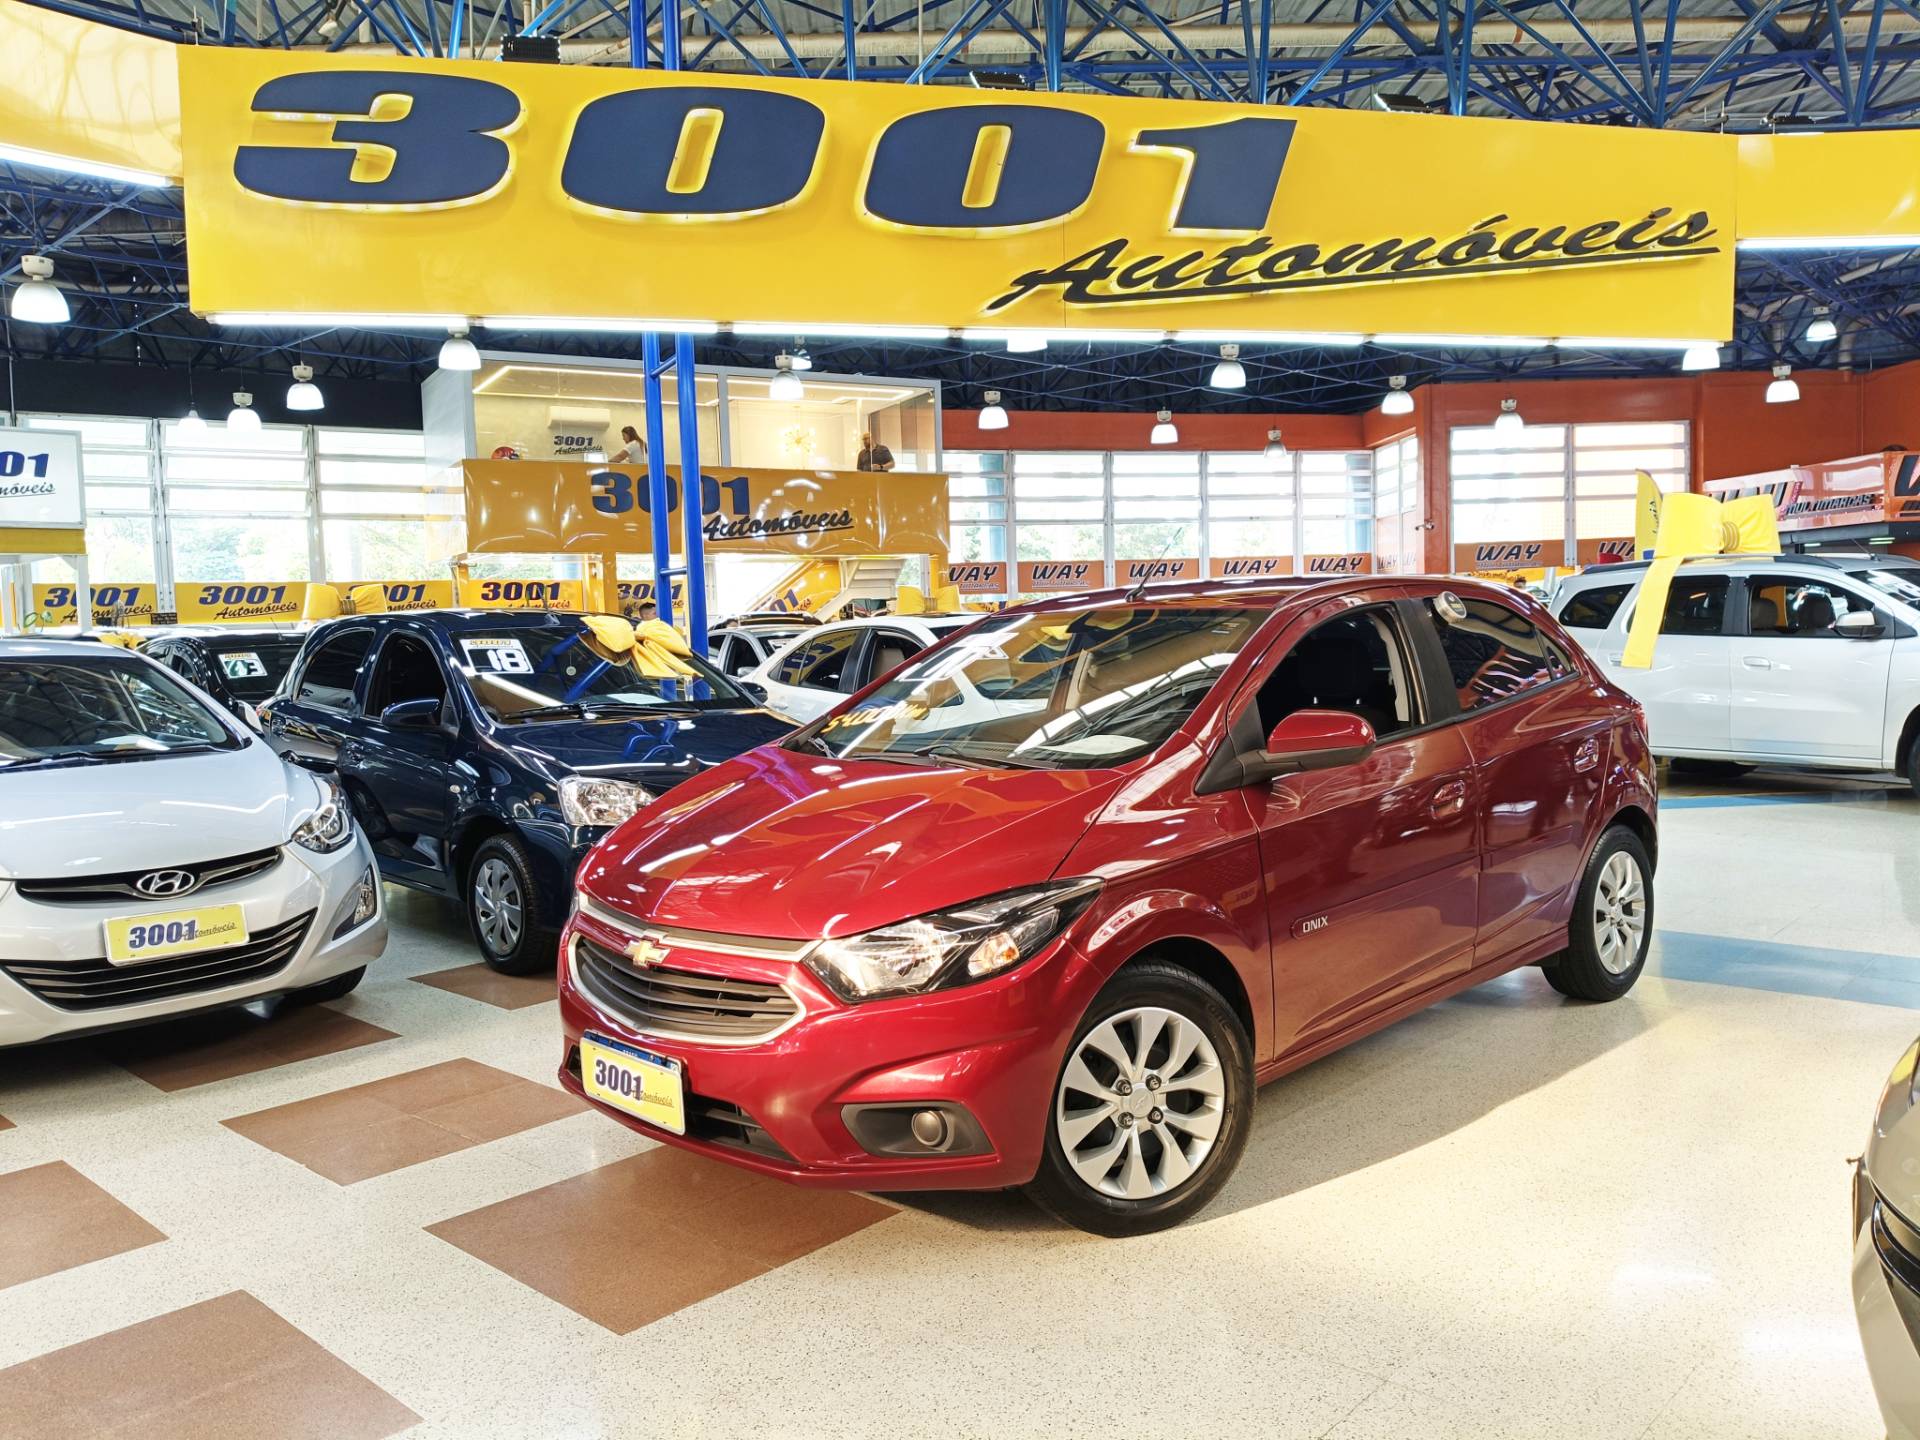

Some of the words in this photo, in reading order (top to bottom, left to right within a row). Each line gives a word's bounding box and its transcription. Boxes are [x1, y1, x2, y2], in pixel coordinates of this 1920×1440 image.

[234, 70, 1296, 230] 3001
[987, 207, 1718, 312] Automóveis
[554, 435, 594, 447] 3001
[703, 510, 856, 542] Automóveis
[1476, 544, 1542, 561] WAY
[1032, 564, 1089, 580] WAY
[1129, 562, 1184, 578] WAY
[1223, 559, 1278, 575] WAY
[1310, 557, 1363, 572] WAY
[199, 585, 286, 605] 3001
[481, 582, 561, 601] 3001
[214, 602, 297, 620] Automóveis
[486, 649, 531, 672] 18
[1303, 915, 1328, 933] ONIX
[129, 919, 196, 949] 3001
[595, 1058, 642, 1101] 3001
